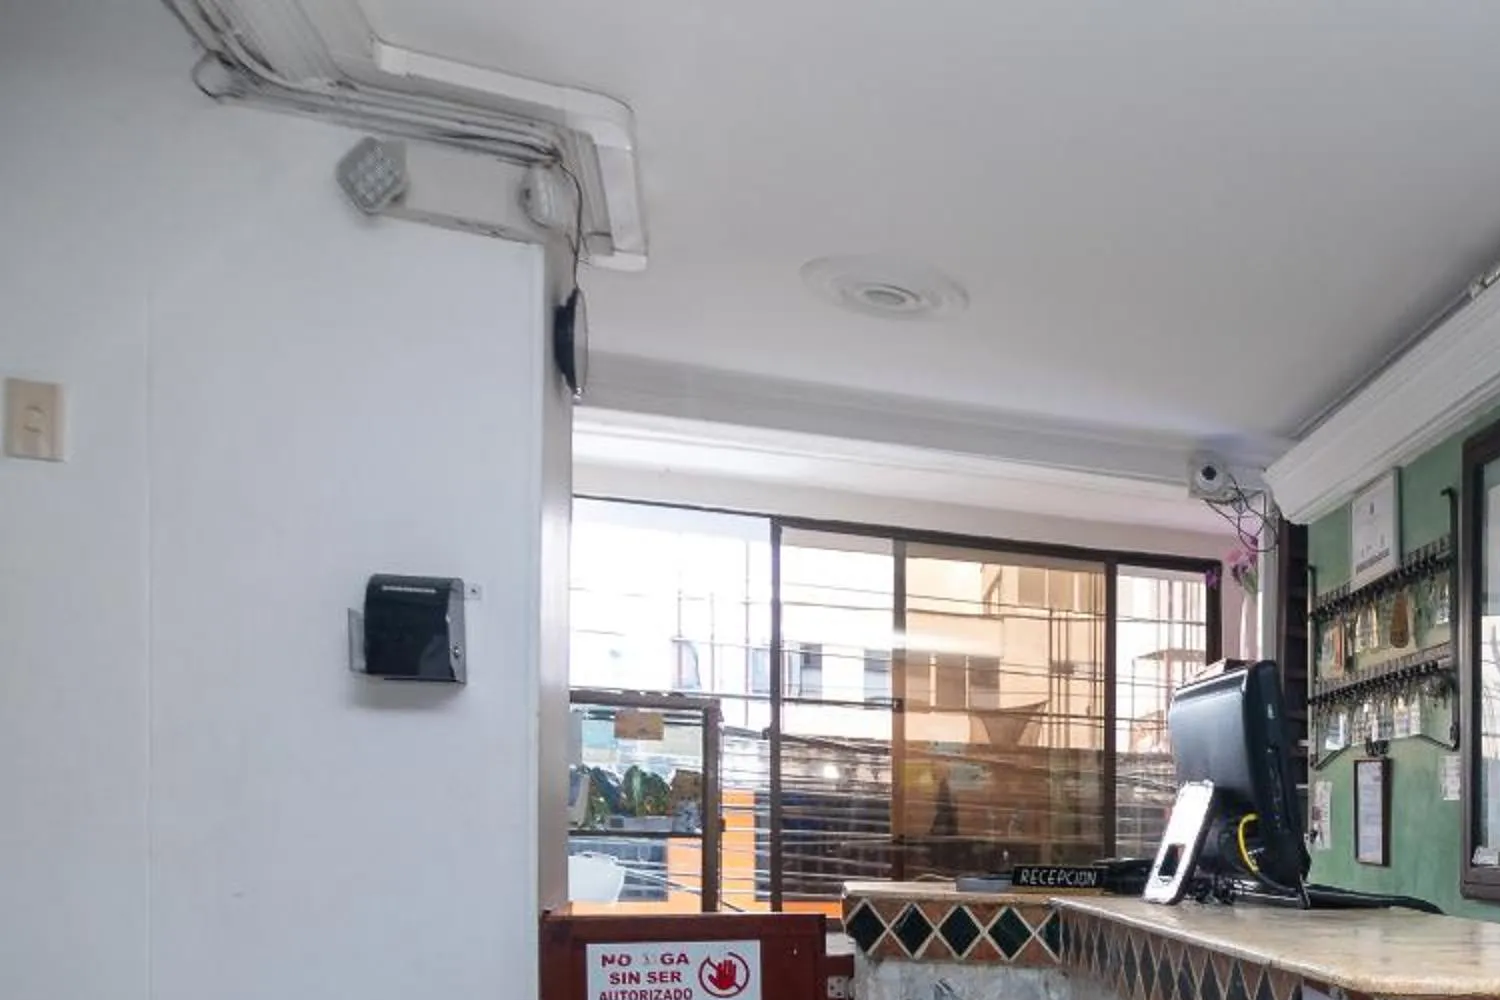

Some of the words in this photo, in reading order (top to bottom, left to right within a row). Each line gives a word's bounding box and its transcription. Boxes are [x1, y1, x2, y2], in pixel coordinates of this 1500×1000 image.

[1020, 867, 1098, 886] RECEPCION
[601, 954, 632, 968] NO
[609, 972, 642, 985] SIN
[646, 971, 683, 984] SER
